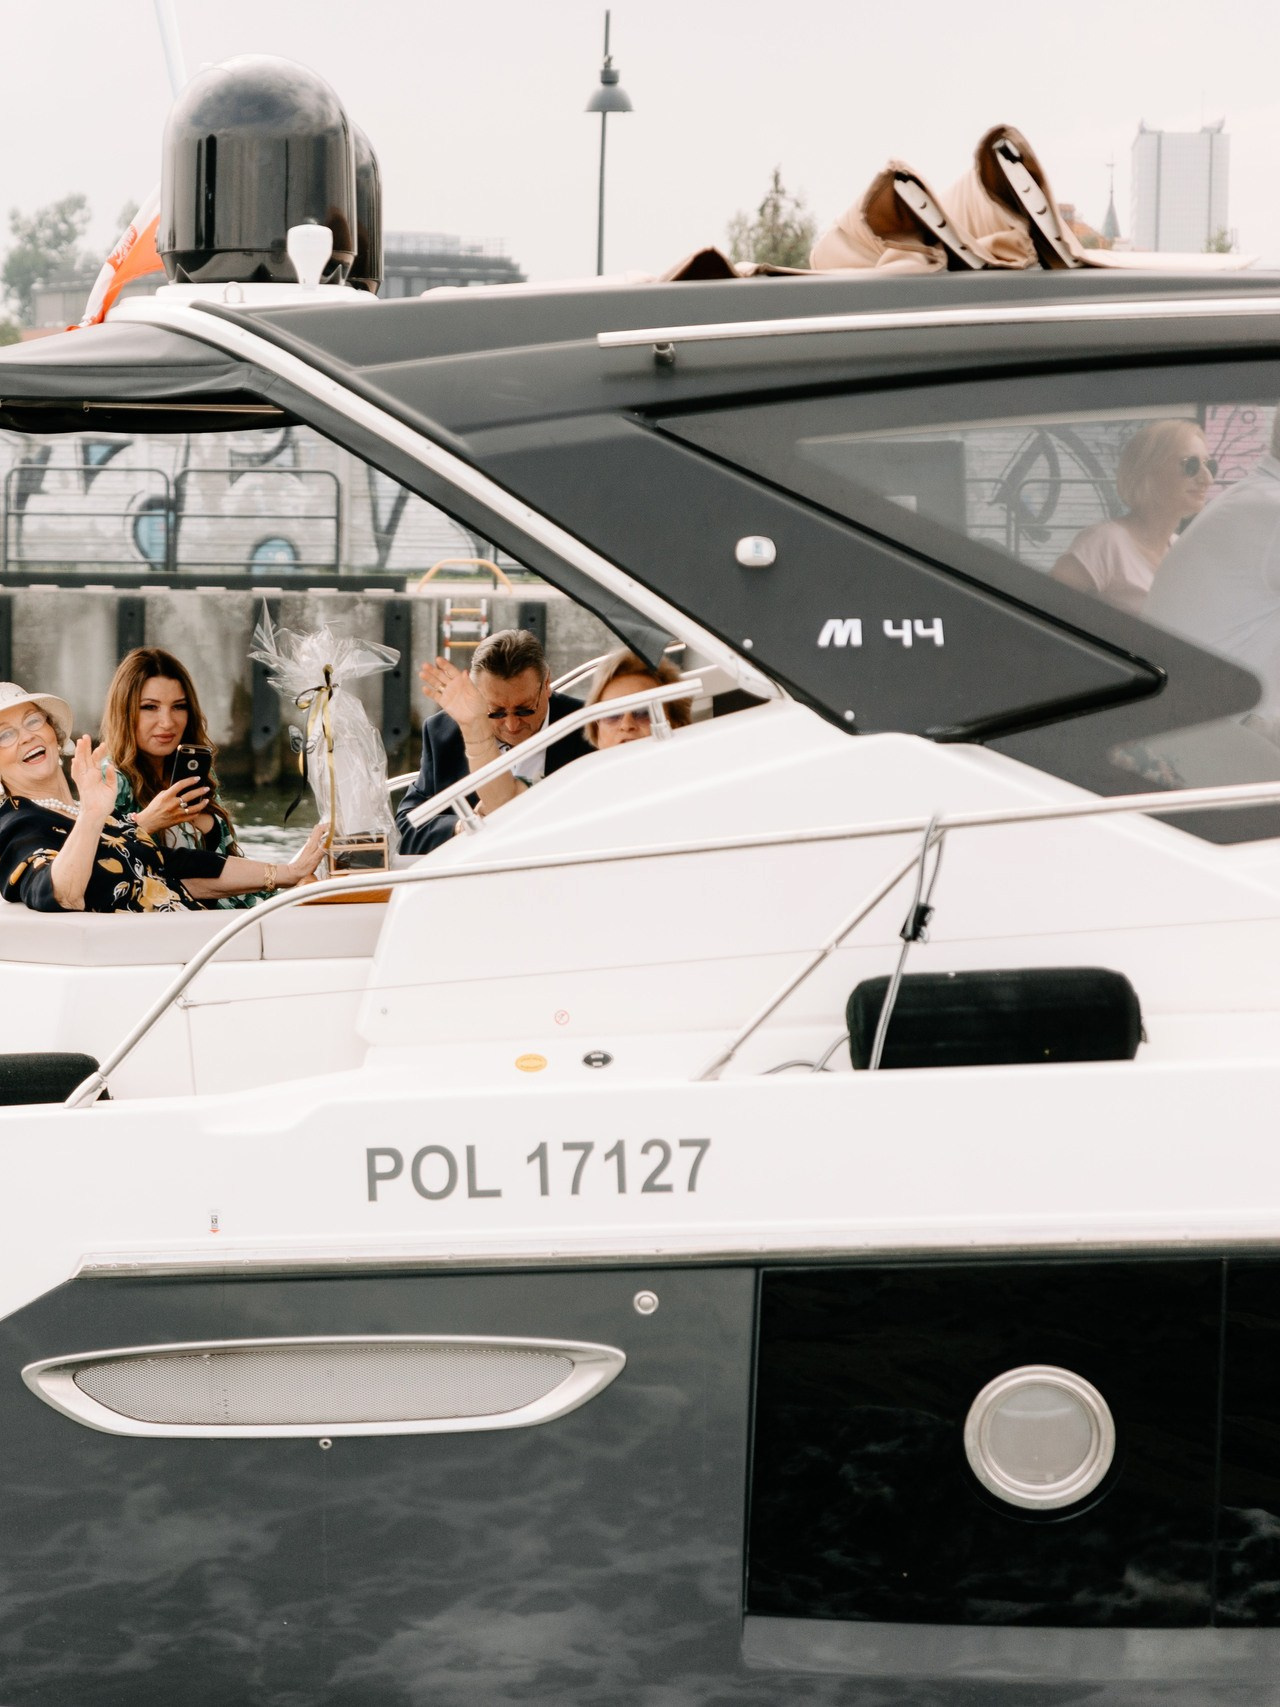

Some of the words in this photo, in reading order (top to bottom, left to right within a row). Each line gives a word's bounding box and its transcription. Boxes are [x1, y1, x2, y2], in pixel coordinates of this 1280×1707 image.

[817, 618, 863, 648] M
[882, 617, 945, 648] 44
[366, 1145, 502, 1202] POL
[526, 1138, 711, 1197] 17127
